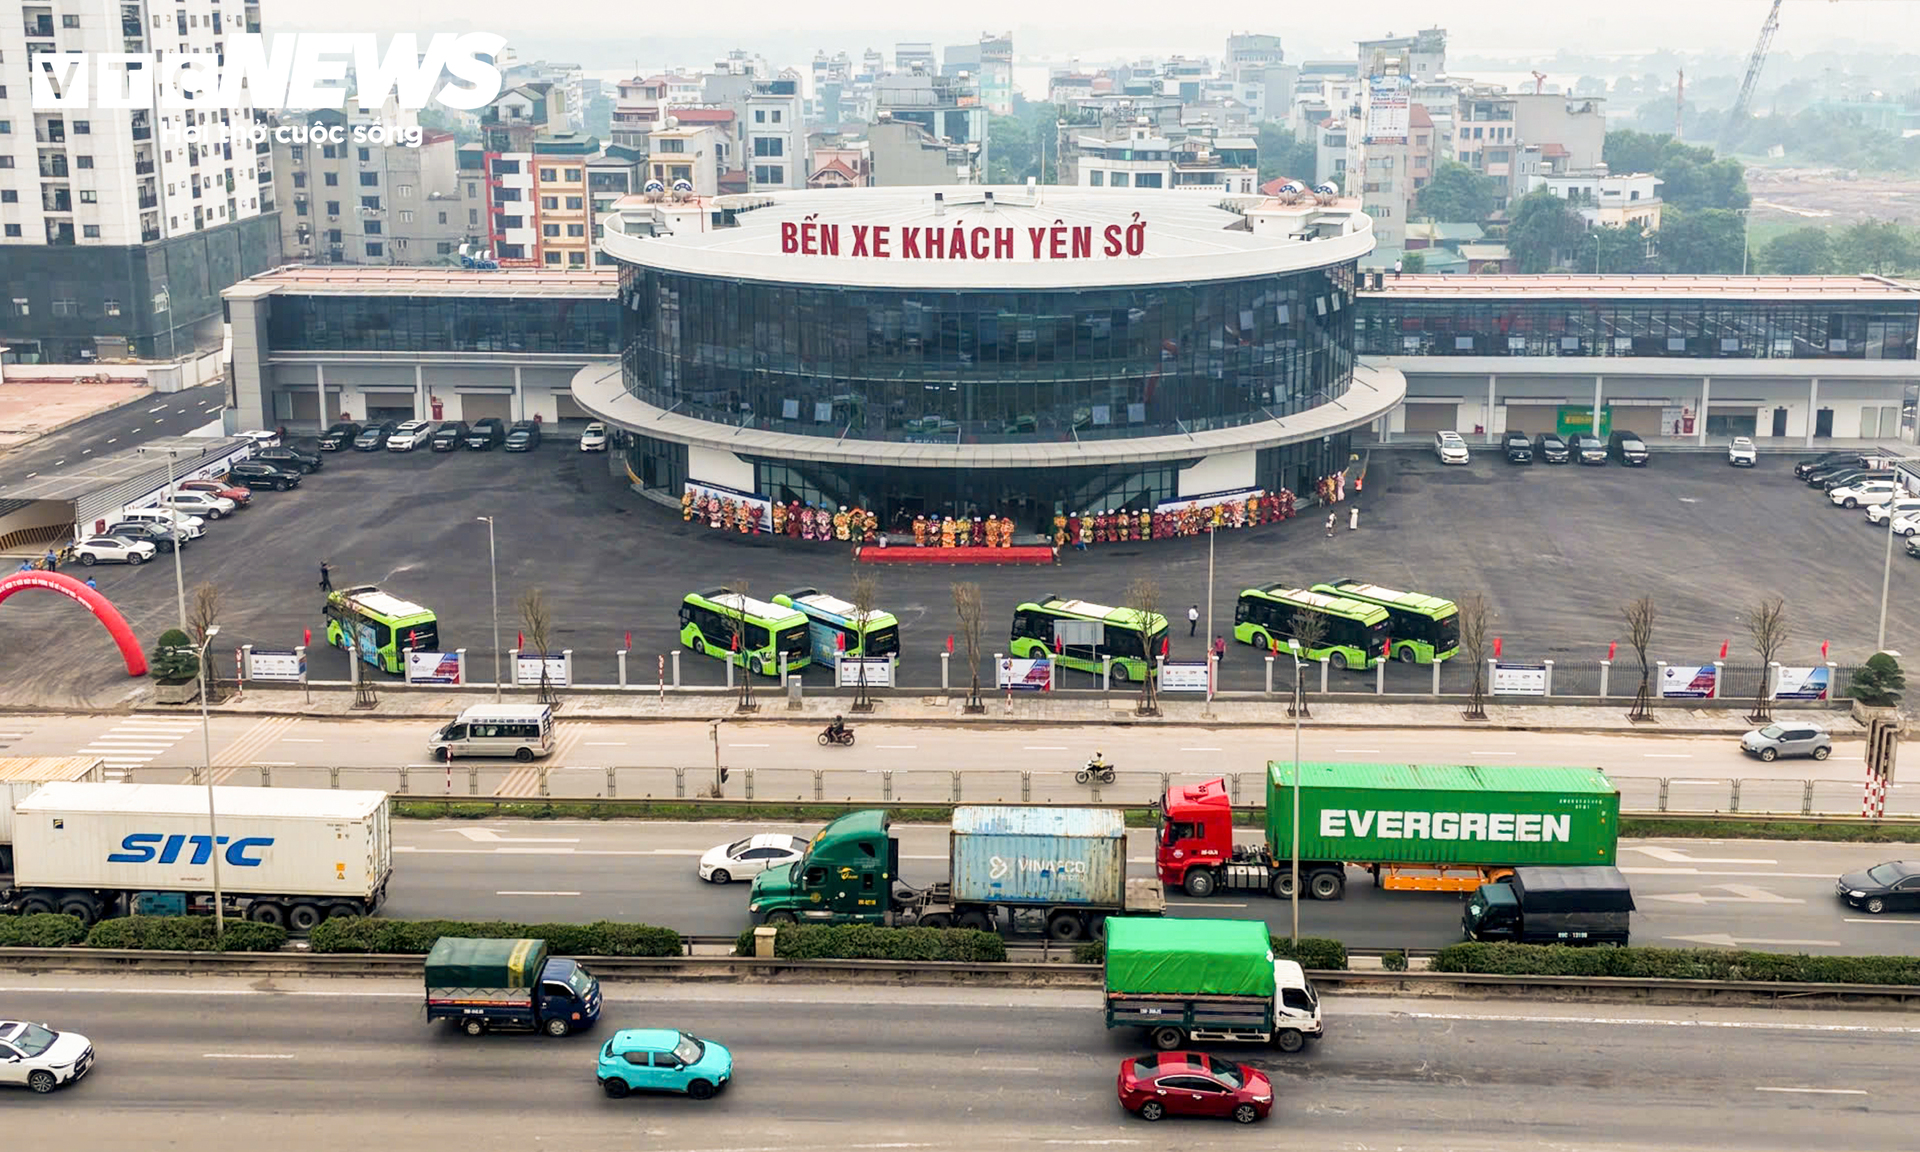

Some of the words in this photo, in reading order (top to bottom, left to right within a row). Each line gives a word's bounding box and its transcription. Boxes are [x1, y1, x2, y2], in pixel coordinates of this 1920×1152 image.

[780, 213, 839, 256] BẾN
[851, 224, 891, 258] XE
[902, 220, 1015, 259] KHÁCH
[1029, 219, 1092, 259] YÊN
[1103, 212, 1147, 257] SỞ
[1319, 809, 1571, 842] EVERGREEN
[107, 833, 275, 867] SITC
